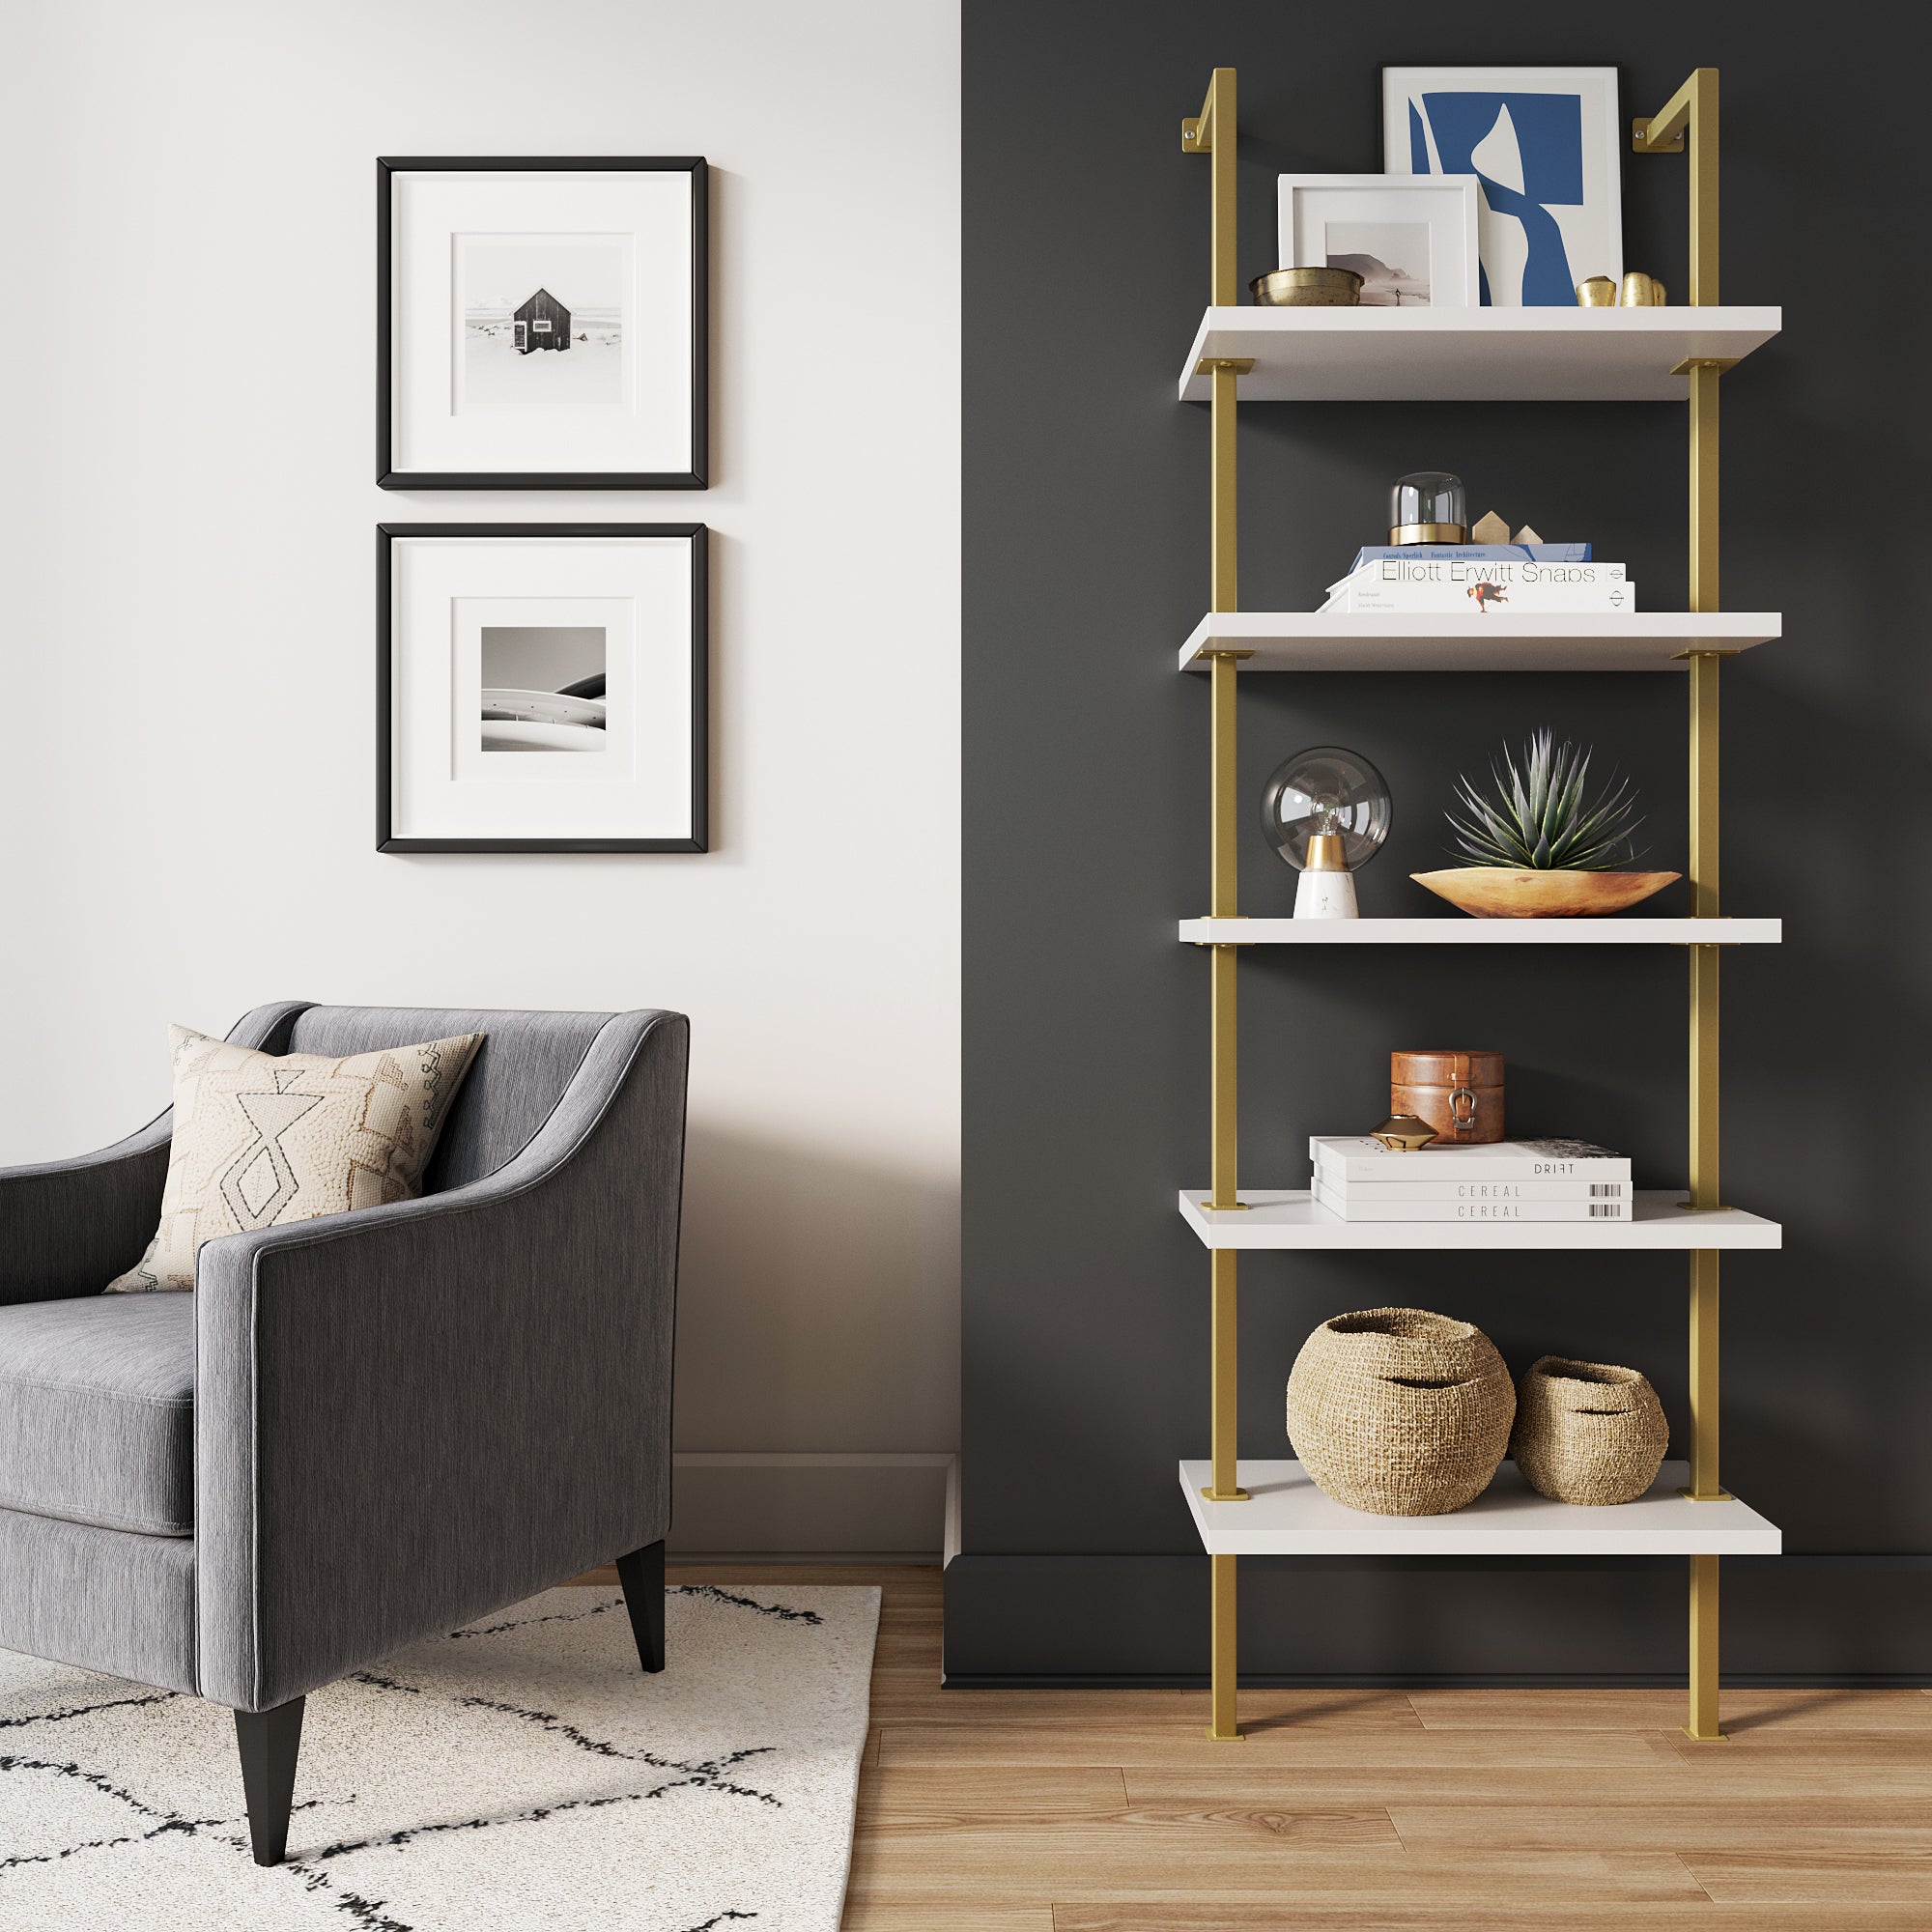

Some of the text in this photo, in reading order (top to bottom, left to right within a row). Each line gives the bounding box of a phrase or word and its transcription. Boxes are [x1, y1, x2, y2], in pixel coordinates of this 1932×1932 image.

[1382, 560, 1596, 582] Elliott Erwitt Snaps
[1534, 1163, 1575, 1175] DRIFT
[1458, 1185, 1520, 1198] CEREAL
[1458, 1206, 1520, 1217] CEREAL
